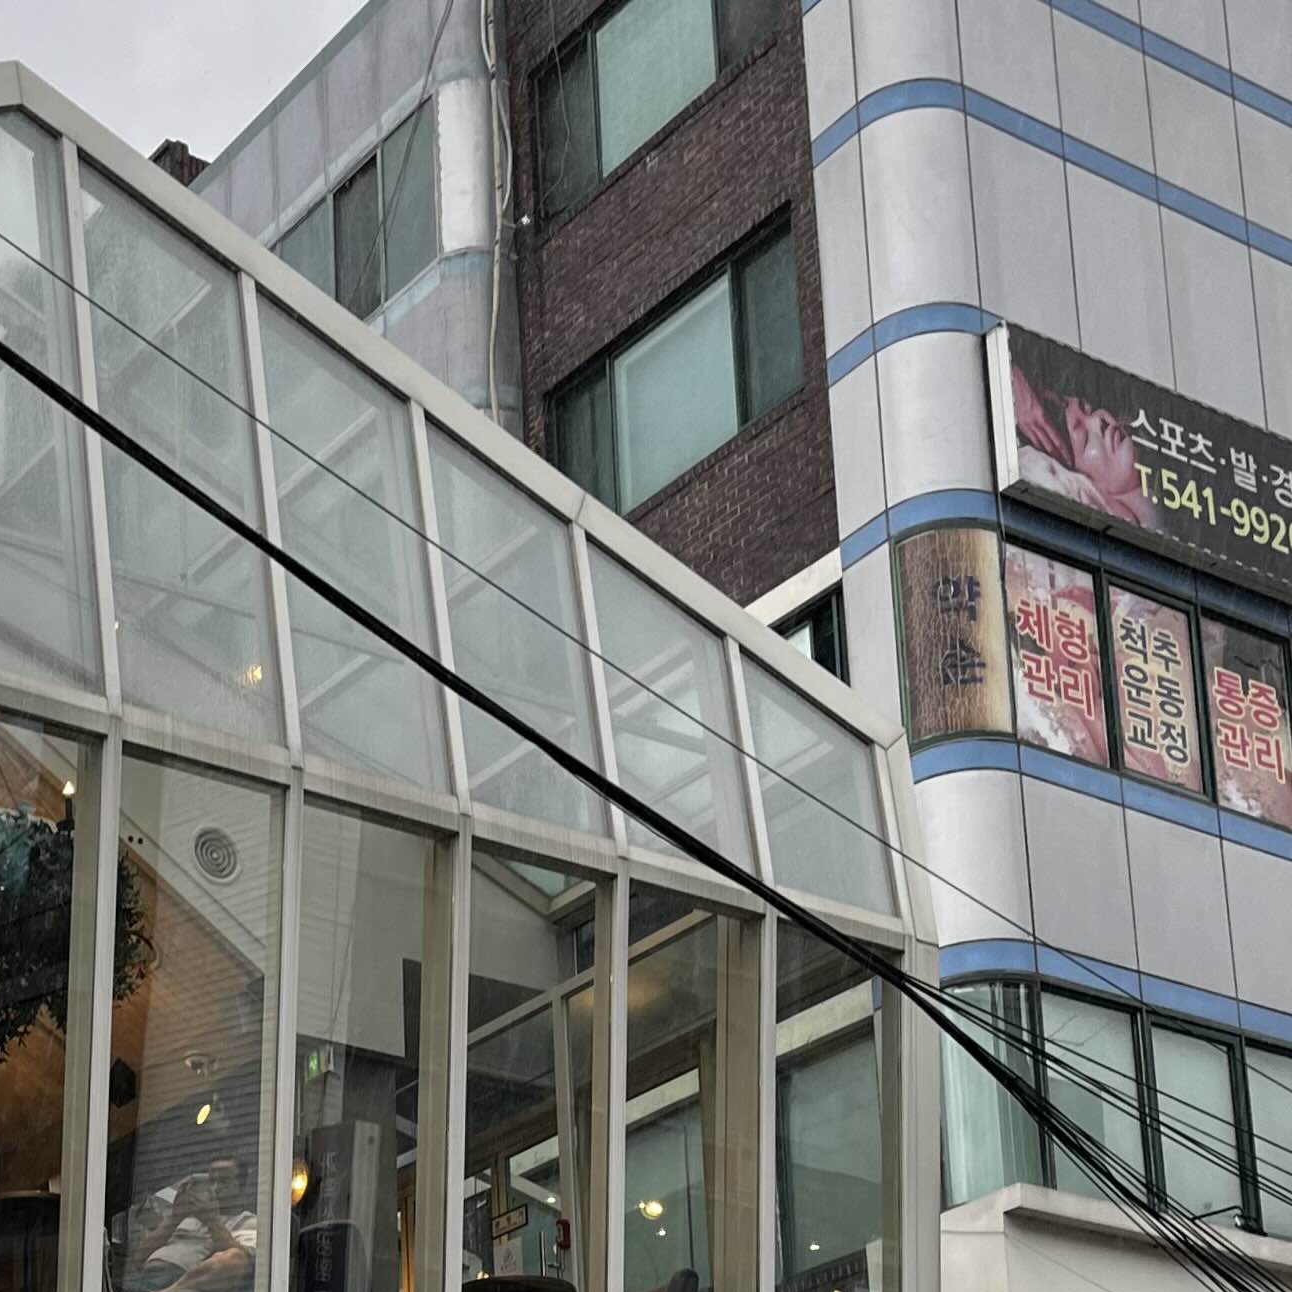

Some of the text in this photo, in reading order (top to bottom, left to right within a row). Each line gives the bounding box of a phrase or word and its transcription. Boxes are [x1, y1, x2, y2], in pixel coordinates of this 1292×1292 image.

[1133, 462, 1292, 555] T.541-992
[1017, 599, 1088, 662] 체형
[1022, 655, 1093, 718] 관리
[1215, 670, 1280, 730] 통증
[1219, 722, 1285, 781] 관리
